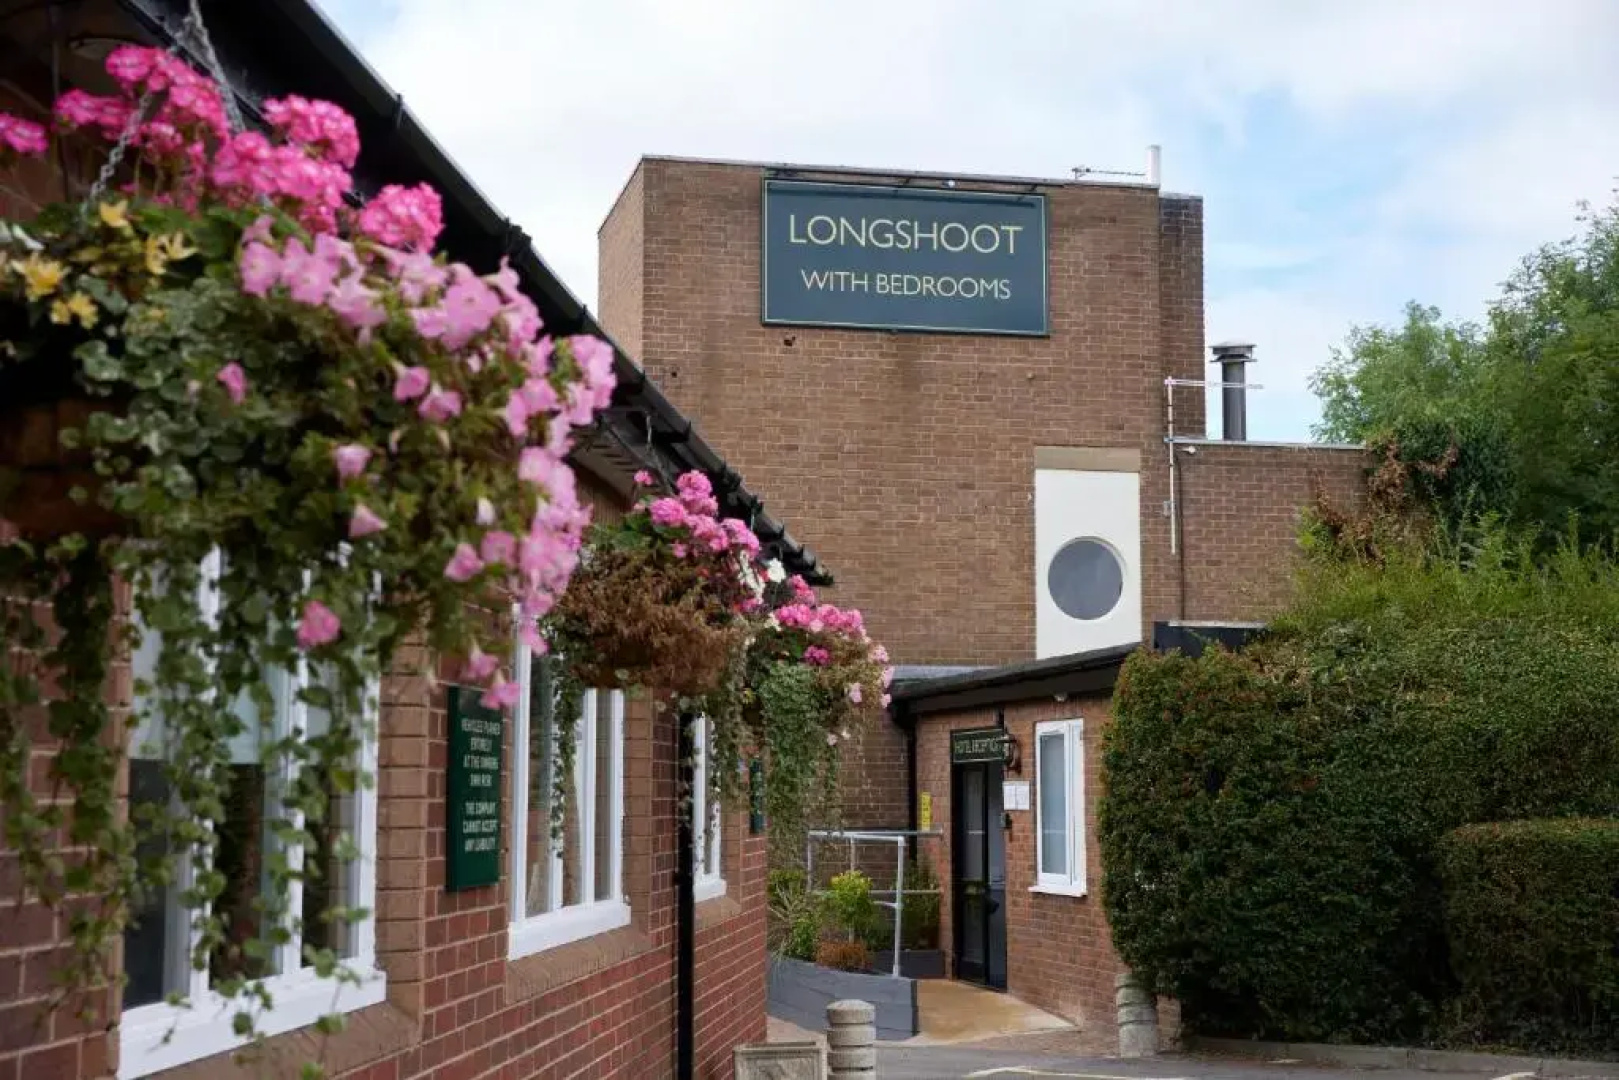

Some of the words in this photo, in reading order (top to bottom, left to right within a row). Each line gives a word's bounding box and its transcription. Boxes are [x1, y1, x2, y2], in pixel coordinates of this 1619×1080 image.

[789, 214, 1023, 254] LONGSHOOT
[801, 269, 868, 292] WITH
[875, 273, 1012, 300] BEDROOMS
